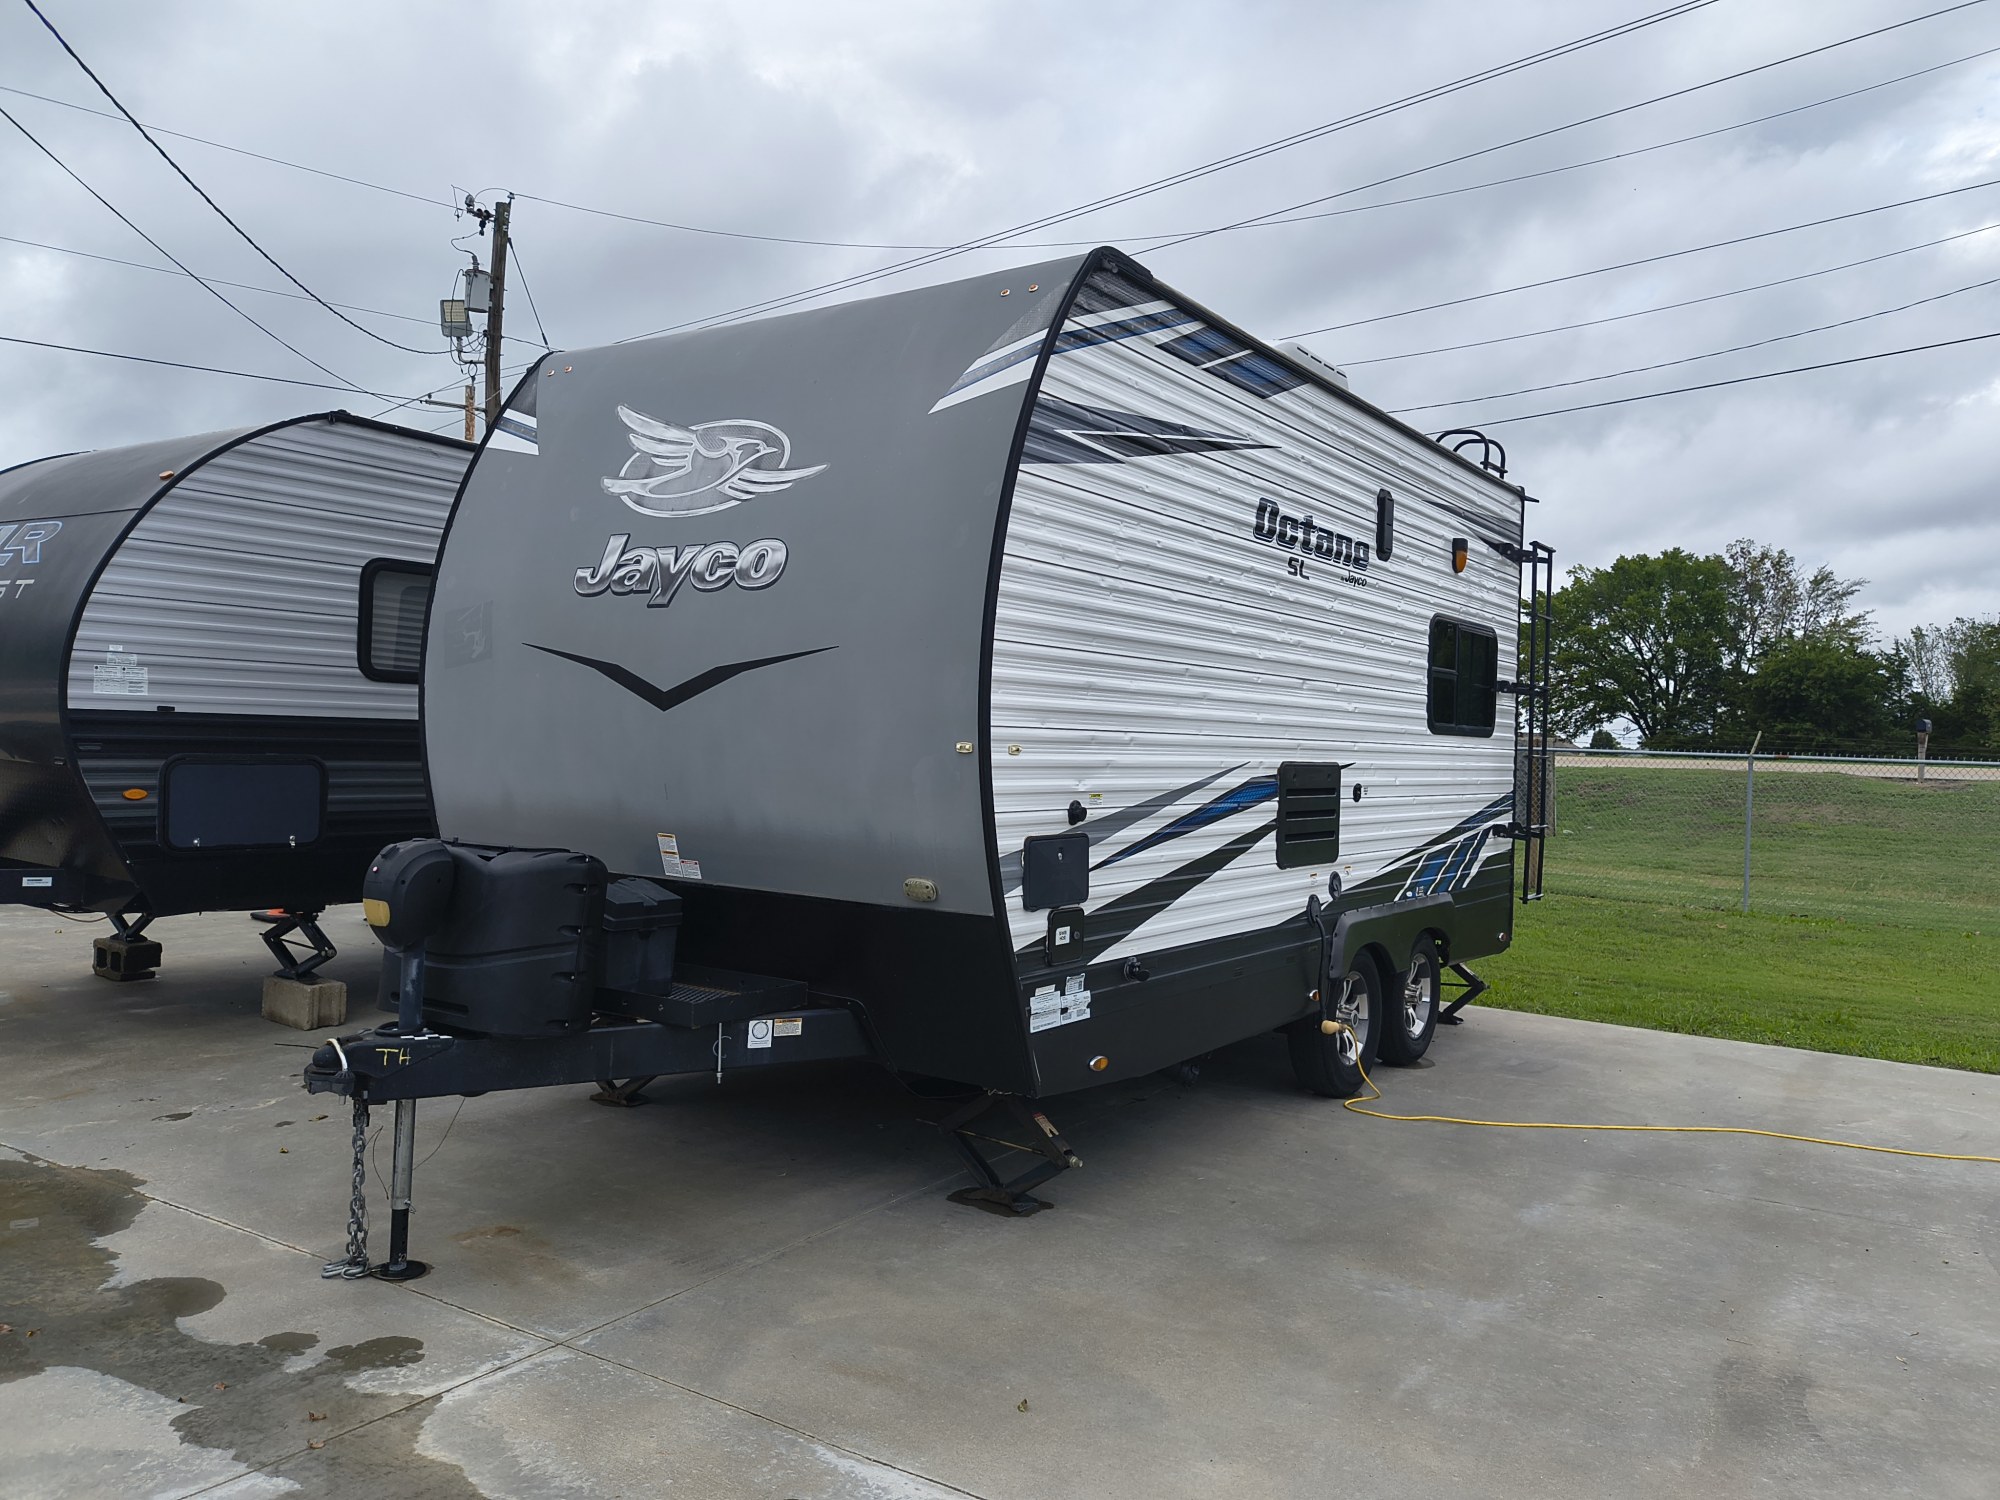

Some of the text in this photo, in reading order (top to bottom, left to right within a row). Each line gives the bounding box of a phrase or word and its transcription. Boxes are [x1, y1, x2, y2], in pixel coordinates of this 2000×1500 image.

[1253, 497, 1370, 571] Octane
[573, 532, 788, 608] Jayco
[1288, 557, 1310, 580] SL
[1345, 570, 1367, 587] Jayco
